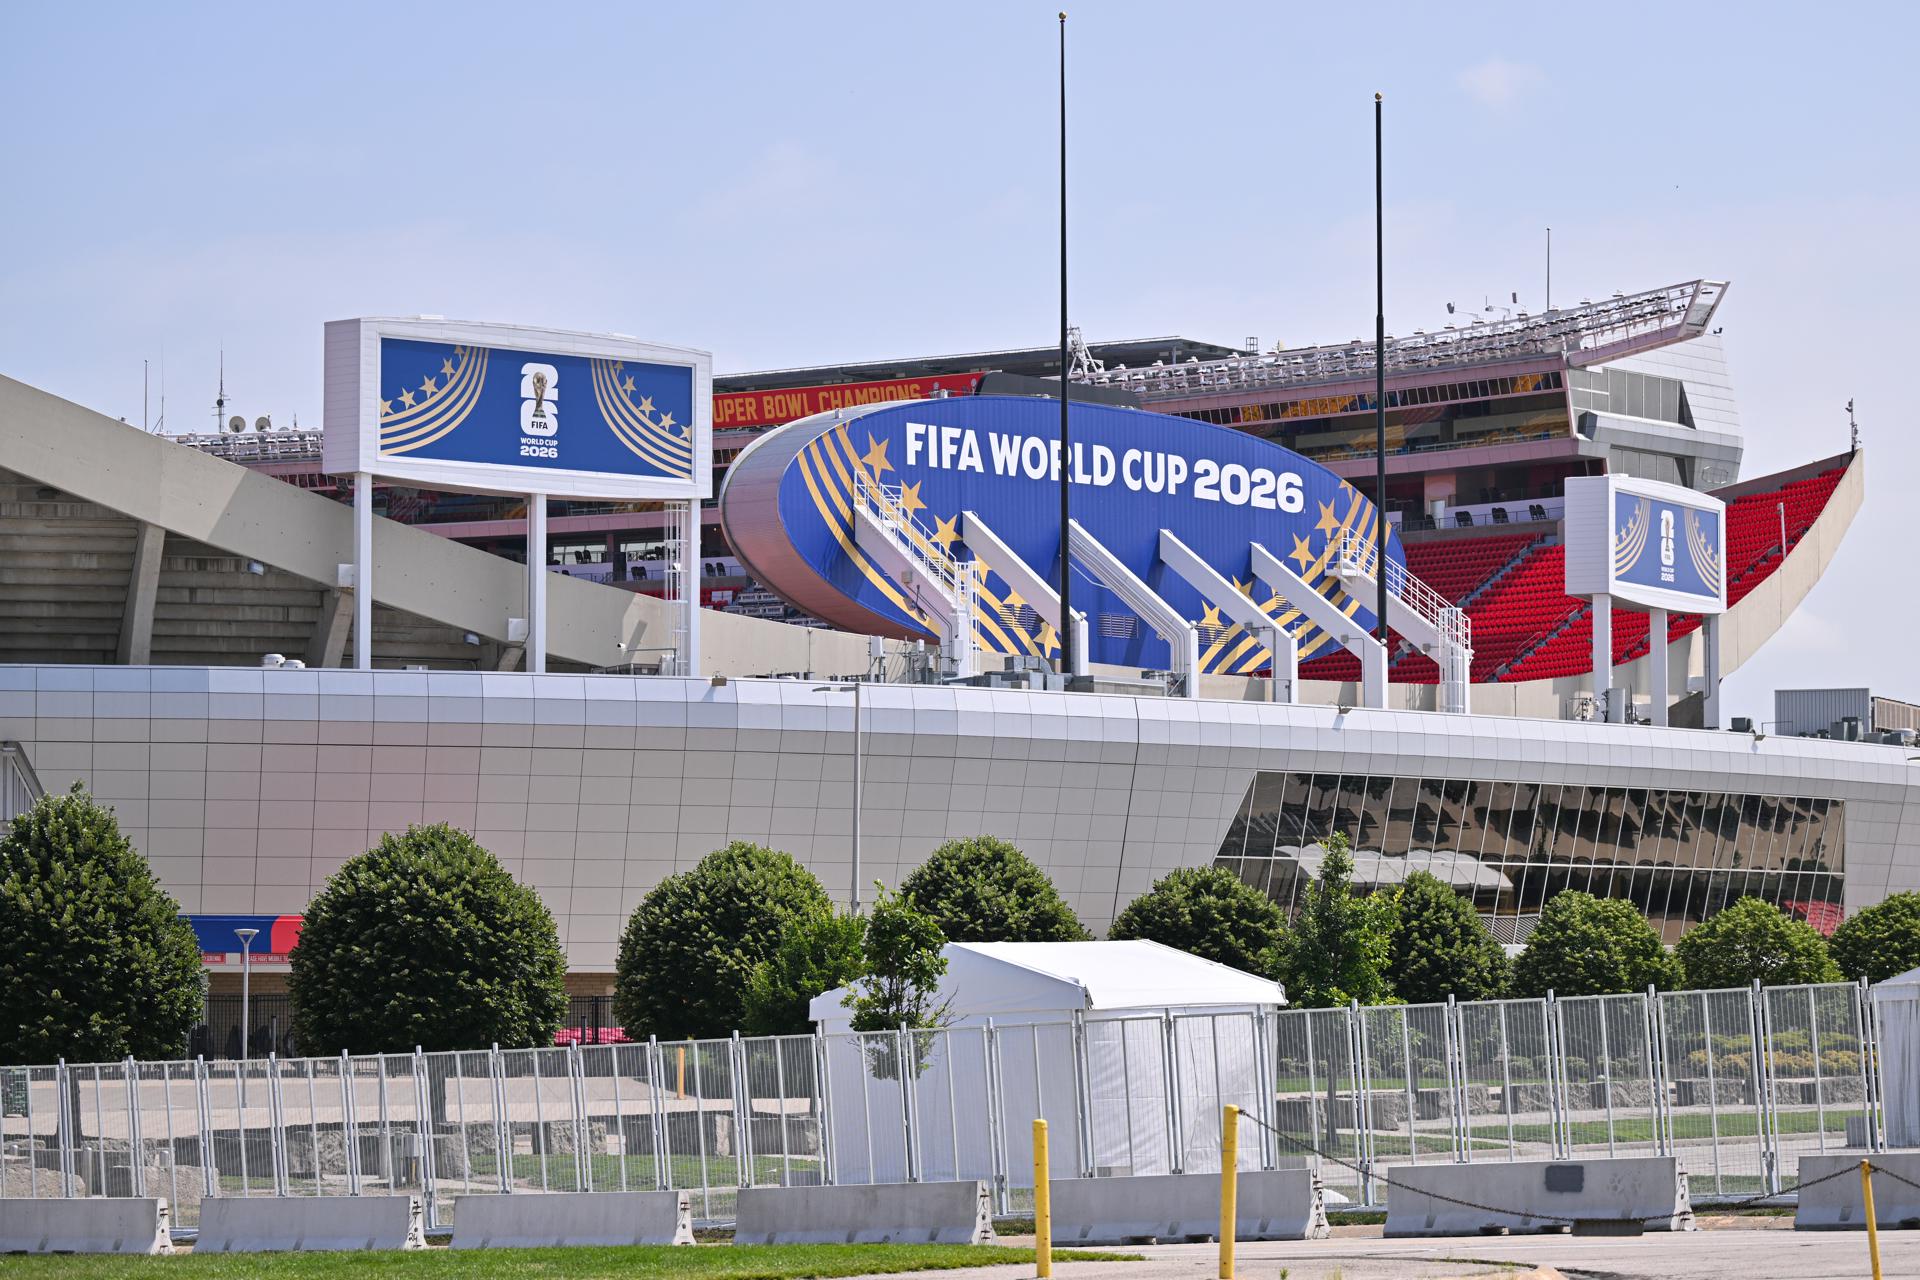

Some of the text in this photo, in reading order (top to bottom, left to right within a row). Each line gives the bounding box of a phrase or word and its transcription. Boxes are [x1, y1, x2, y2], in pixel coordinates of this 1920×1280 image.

[713, 384, 921, 422] UPER BOWL CHAMPIONS
[531, 421, 548, 429] FIFA
[520, 437, 558, 447] WORLD CUP
[520, 445, 558, 458] 2026
[906, 422, 1304, 513] FIFA WORLD CUP 2026
